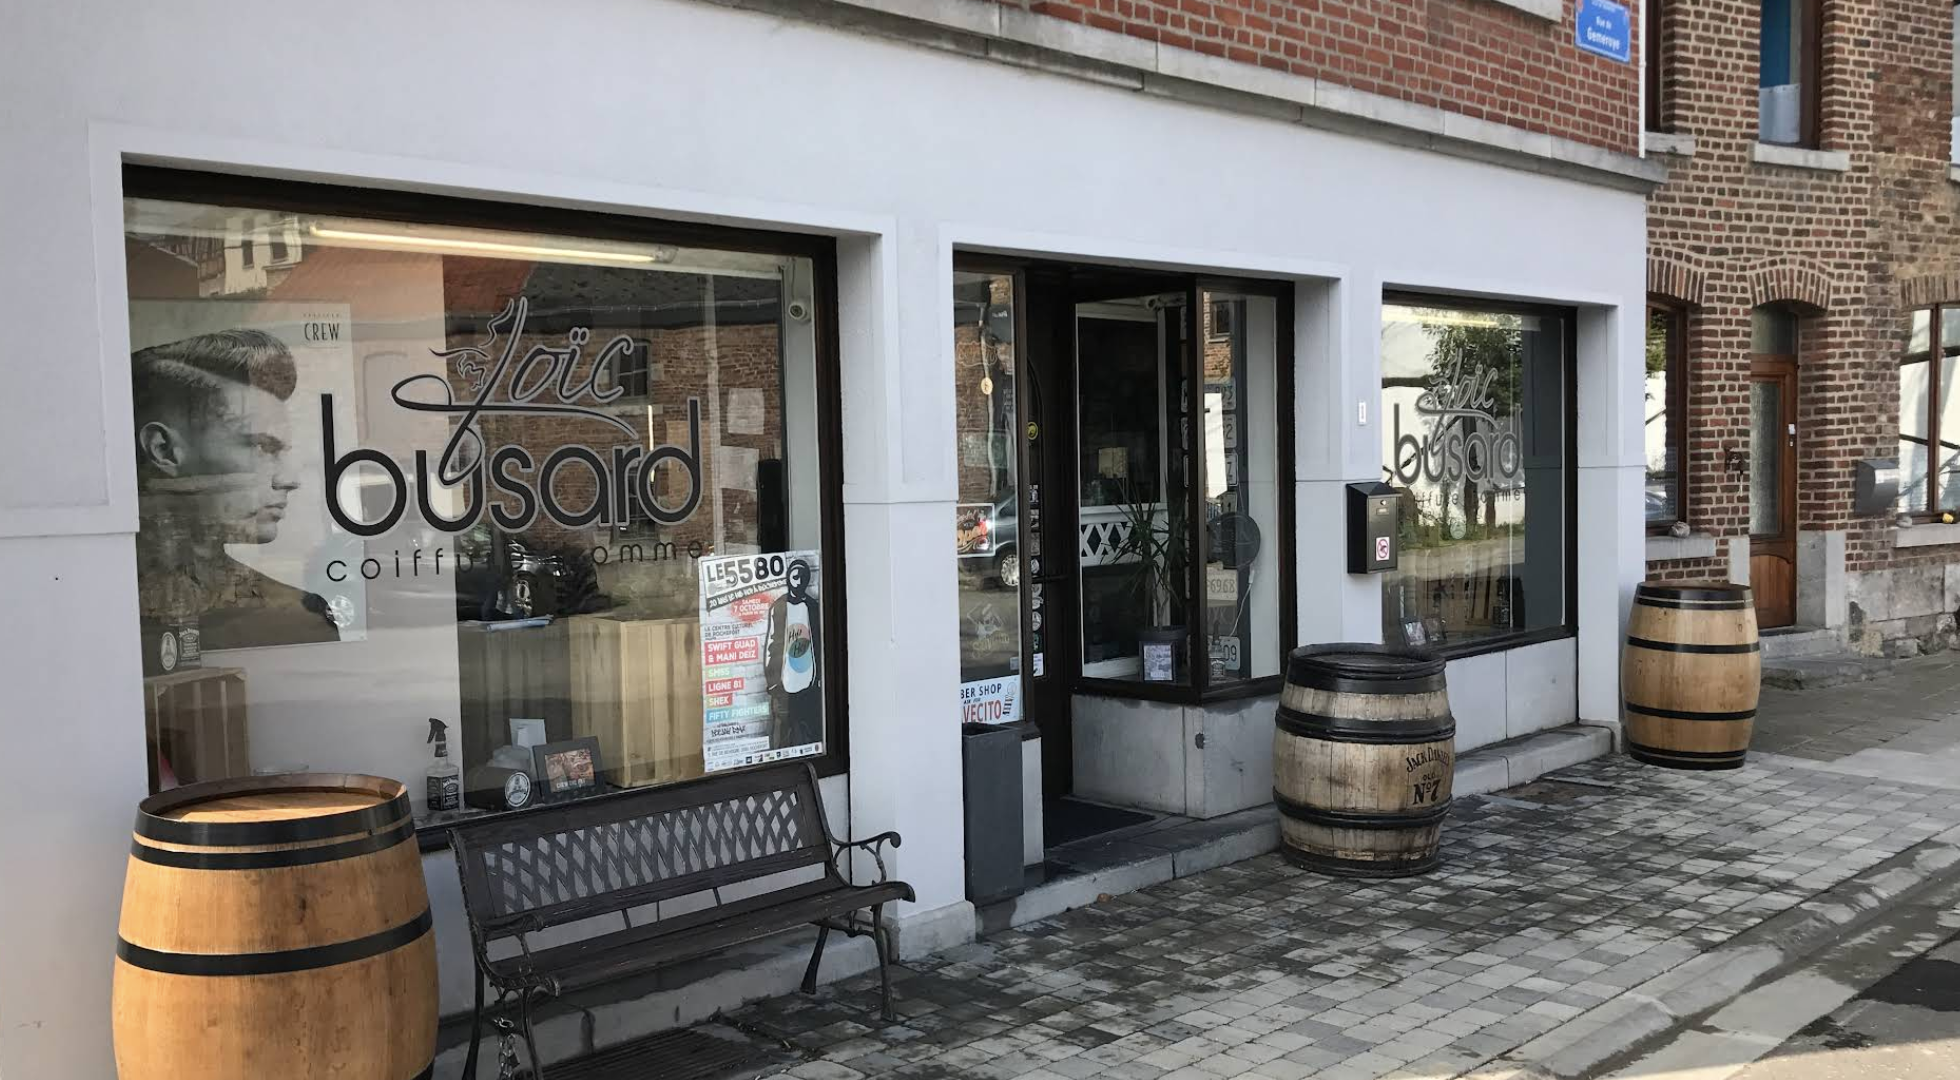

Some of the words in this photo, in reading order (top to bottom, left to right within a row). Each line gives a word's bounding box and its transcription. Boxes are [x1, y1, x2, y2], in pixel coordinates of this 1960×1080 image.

[304, 322, 340, 341] CREW
[1393, 402, 1523, 487] busard
[318, 393, 703, 538] busard
[708, 642, 733, 652] SWIFT
[716, 652, 737, 662] MANI
[708, 682, 731, 692] LIGNE
[978, 682, 1002, 697] SHOP
[709, 710, 730, 721] FIFTY
[1406, 752, 1428, 773] JACK
